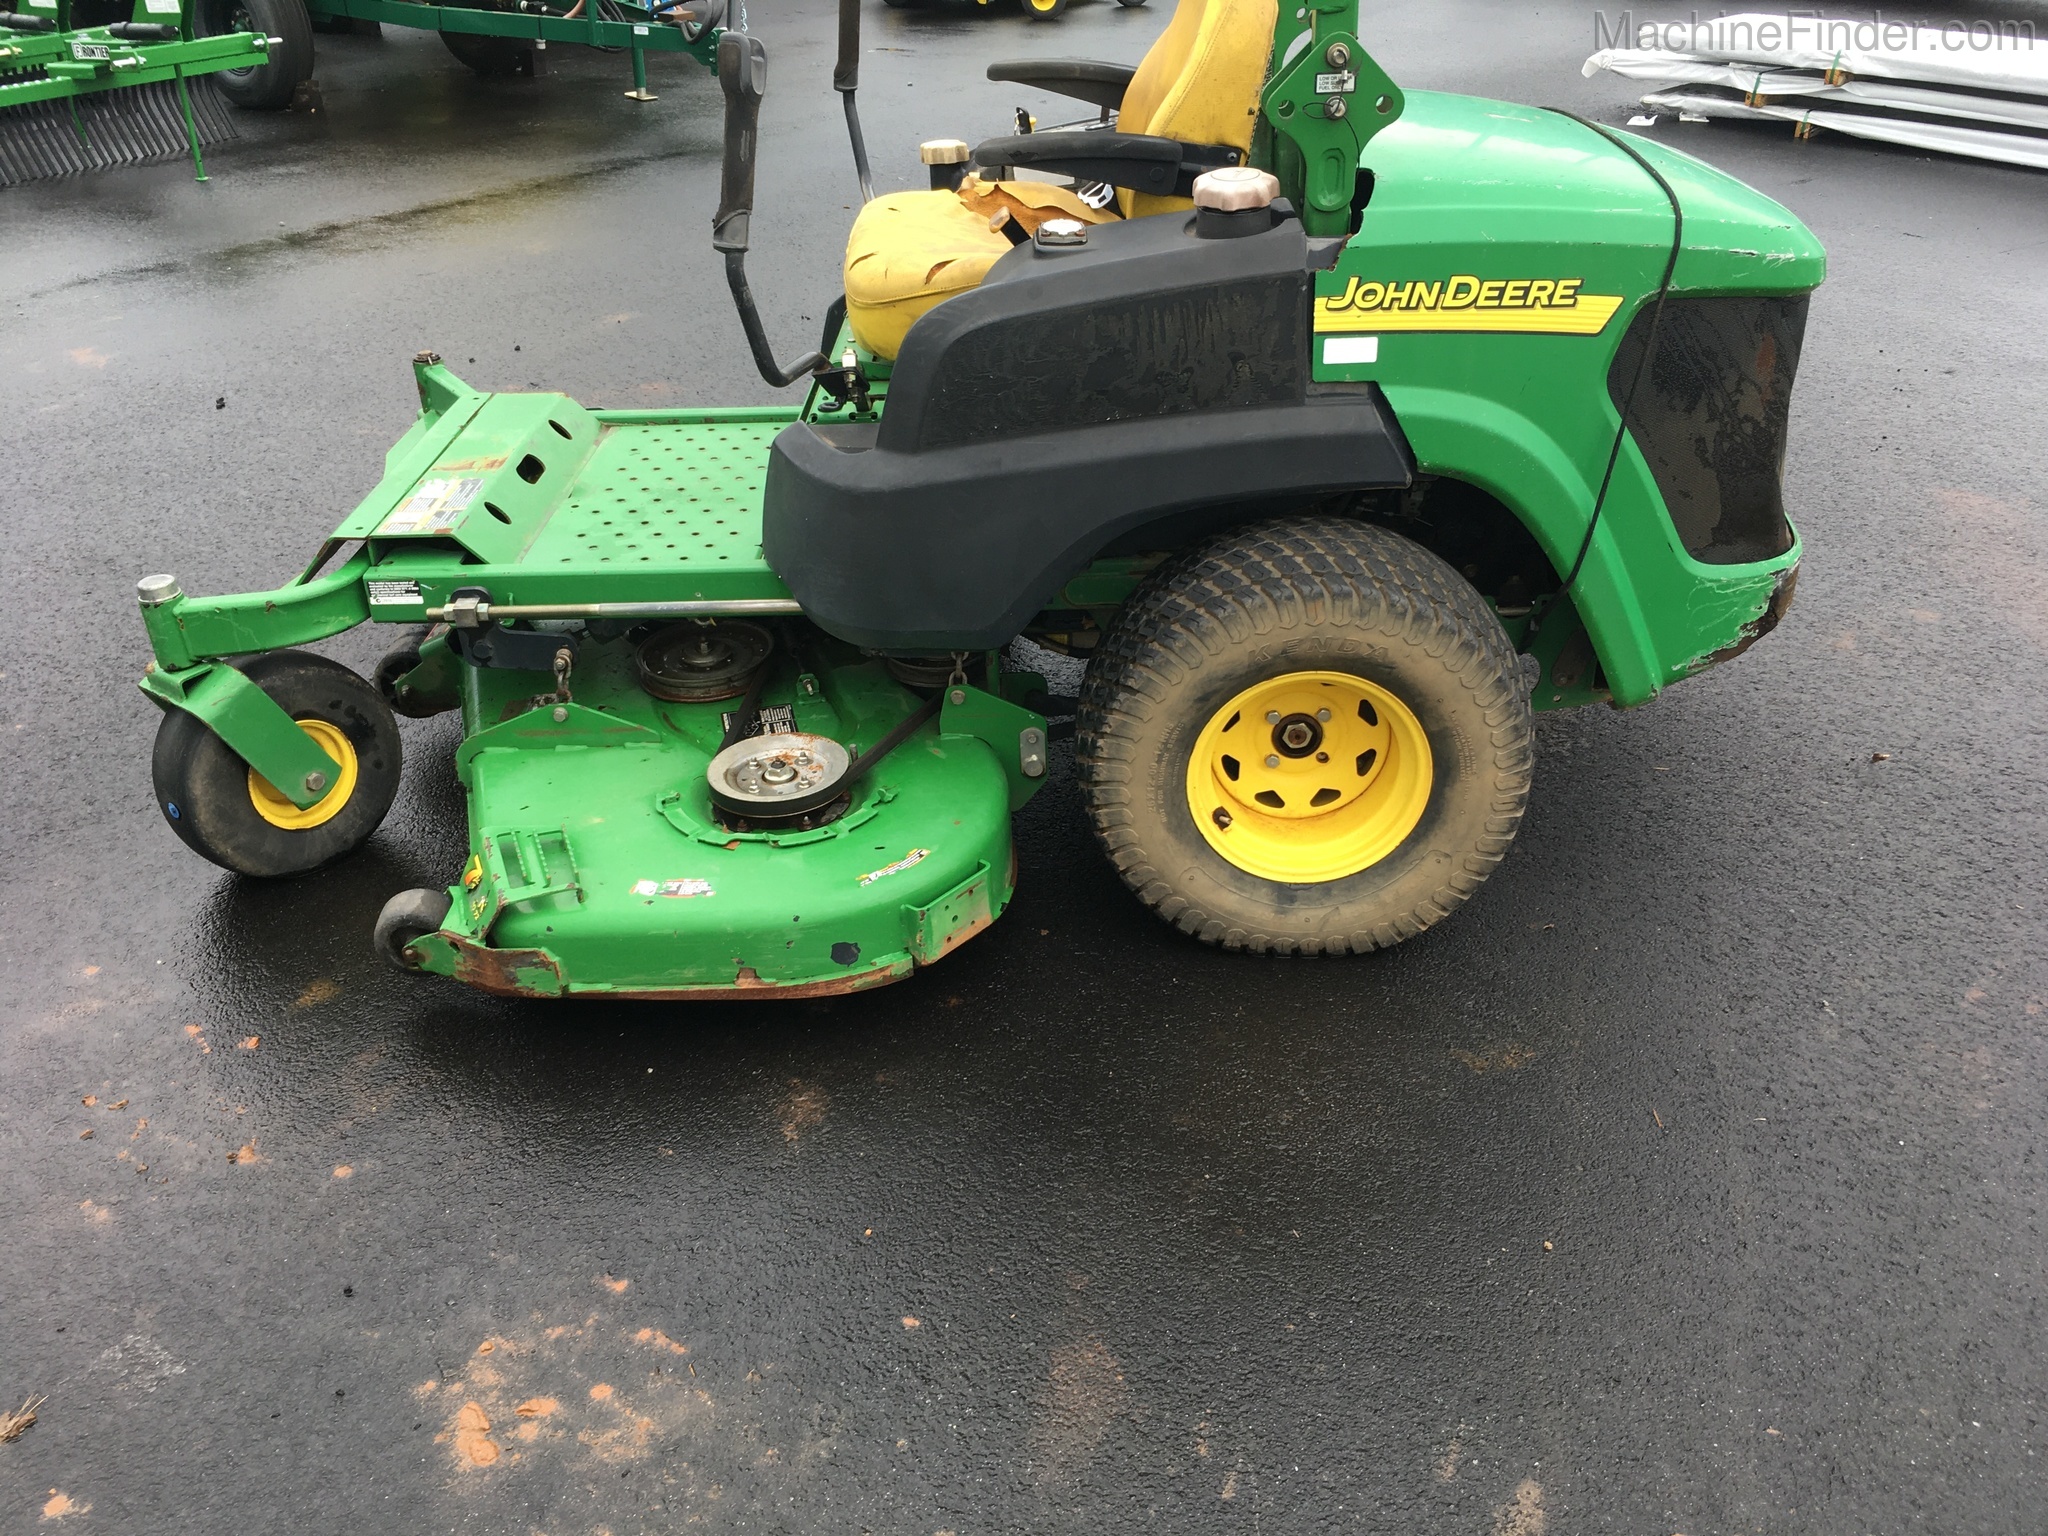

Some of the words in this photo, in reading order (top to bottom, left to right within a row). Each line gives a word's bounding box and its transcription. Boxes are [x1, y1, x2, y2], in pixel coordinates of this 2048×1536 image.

[1326, 275, 1443, 311] JOHN
[1441, 274, 1584, 309] DEERE
[1247, 636, 1389, 662] KENDA
